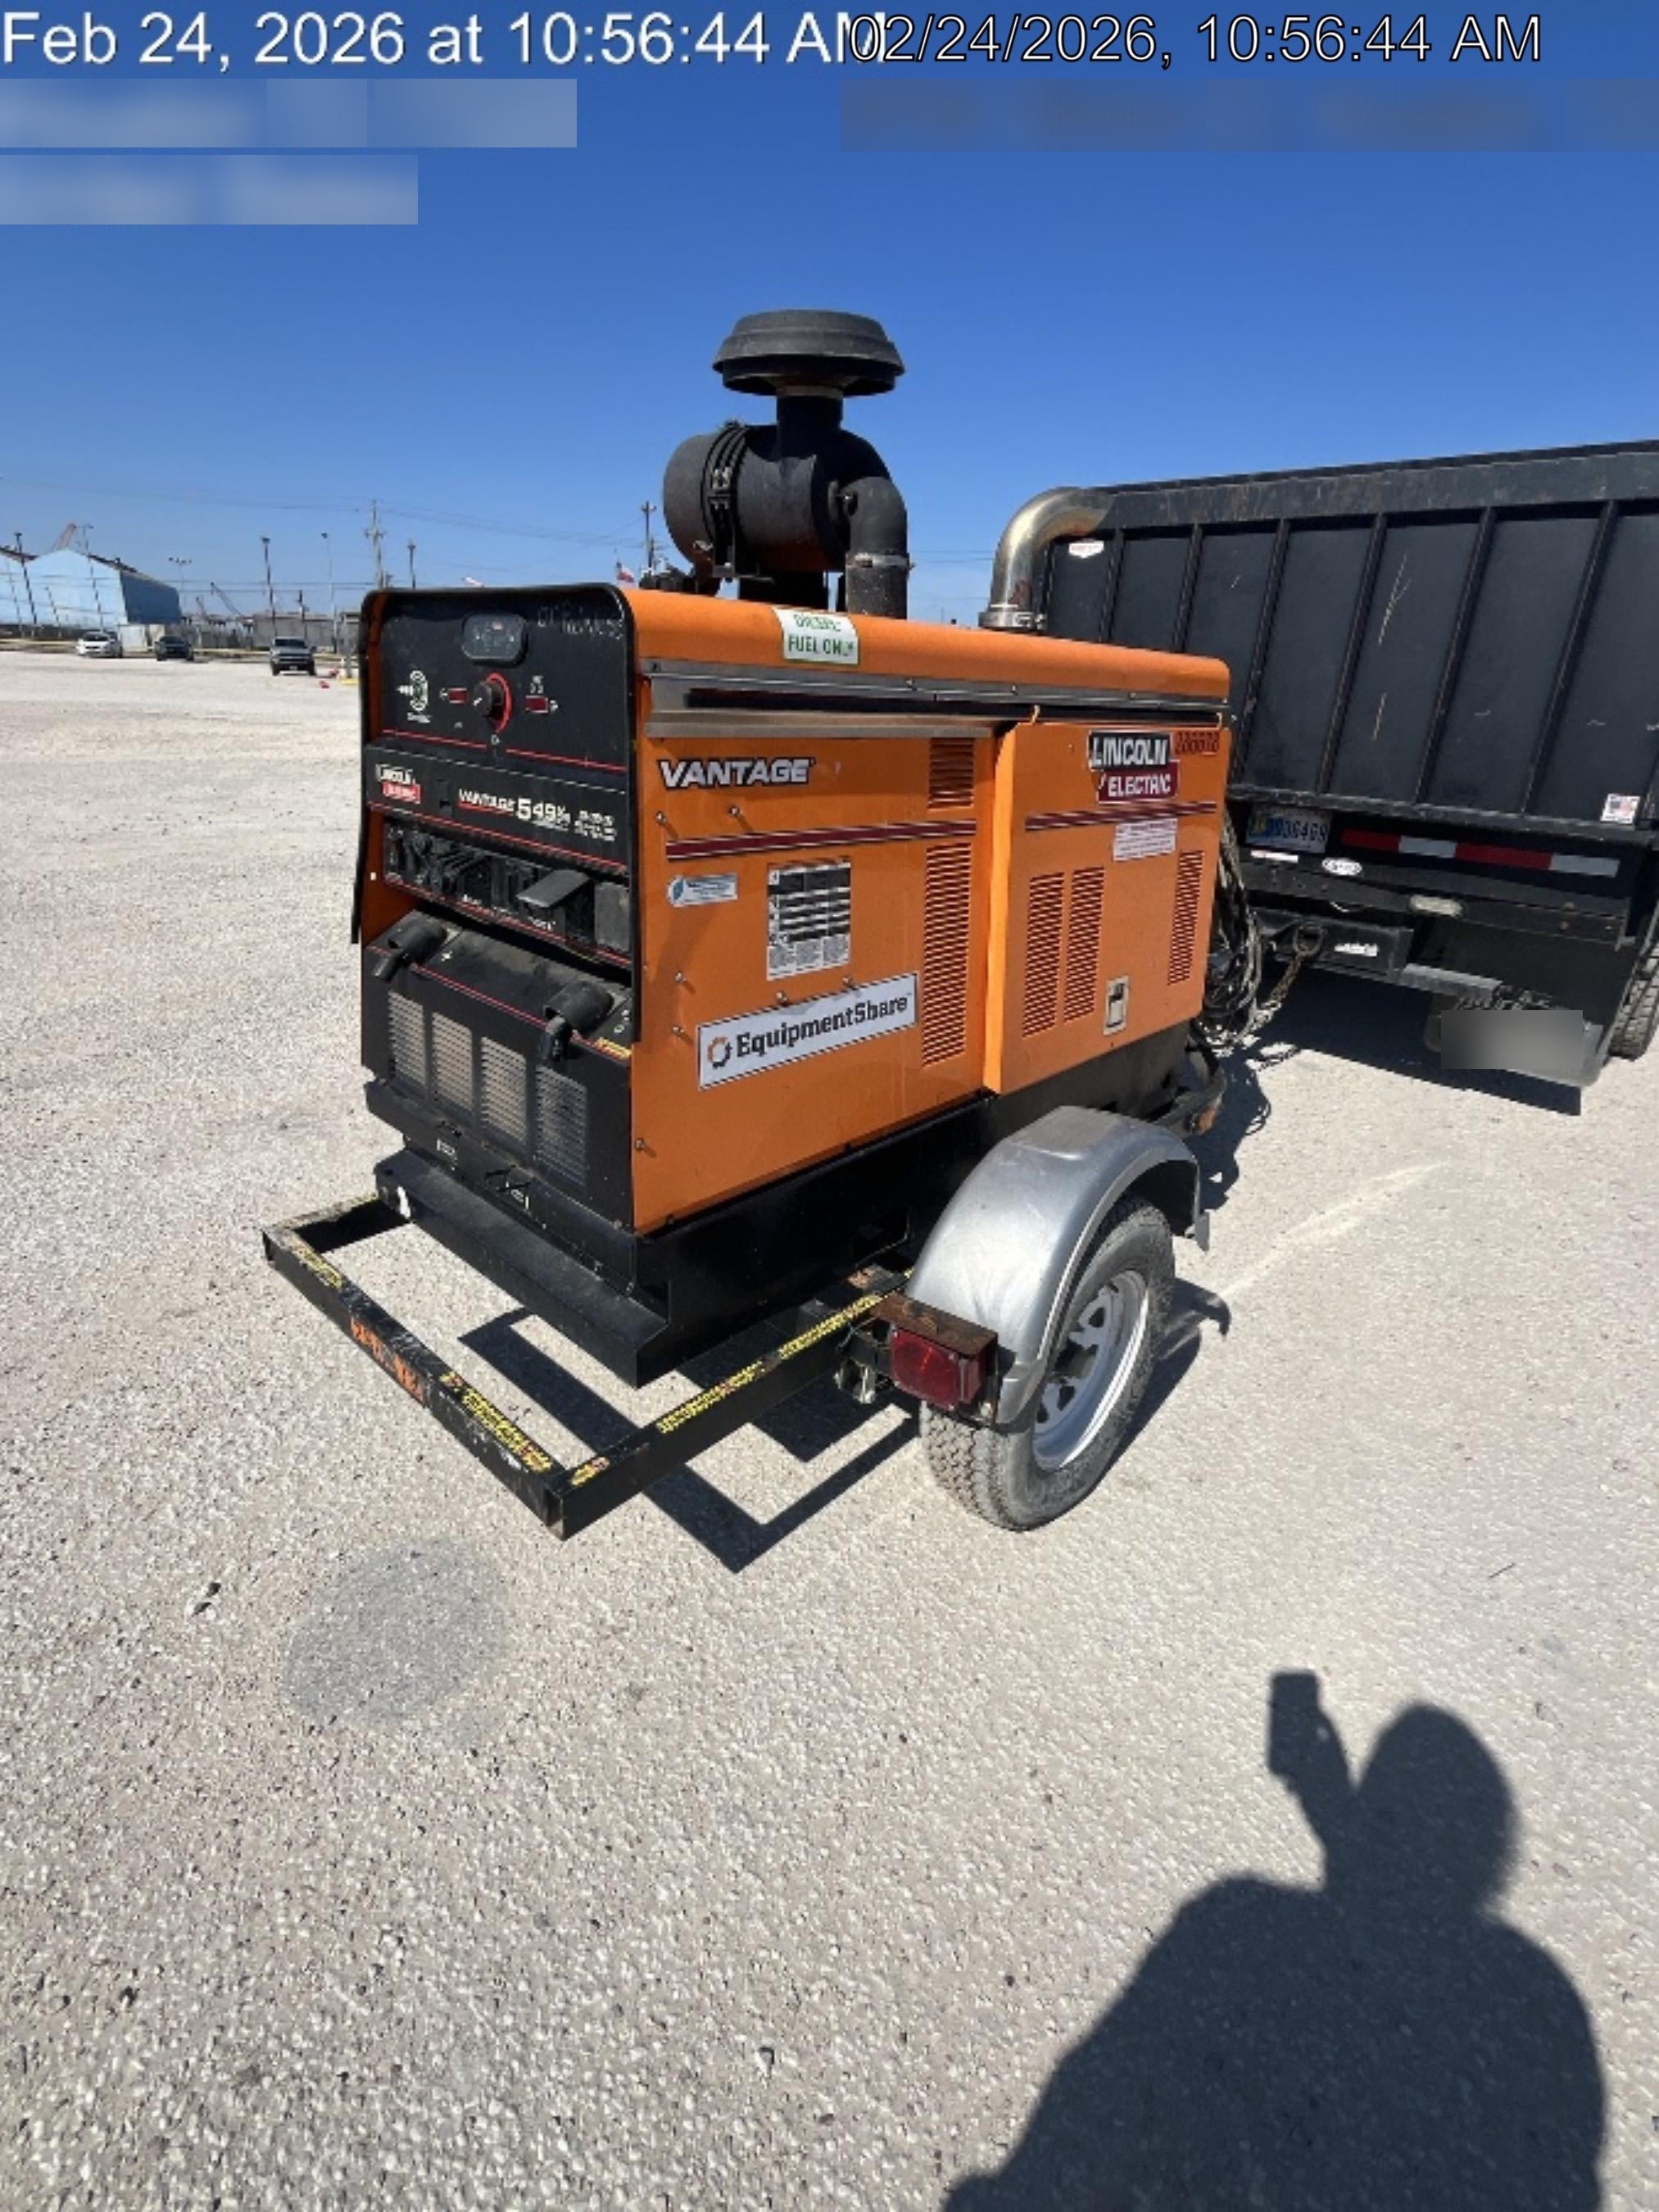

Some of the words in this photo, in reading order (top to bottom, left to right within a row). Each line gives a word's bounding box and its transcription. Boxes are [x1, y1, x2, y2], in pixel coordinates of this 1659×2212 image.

[788, 633, 819, 655] FUEL
[1090, 737, 1169, 768] LINCOLN
[658, 757, 811, 790] VANTAGE
[1107, 773, 1172, 798] ELECTRIC
[736, 996, 909, 1057] EquipmentShare
